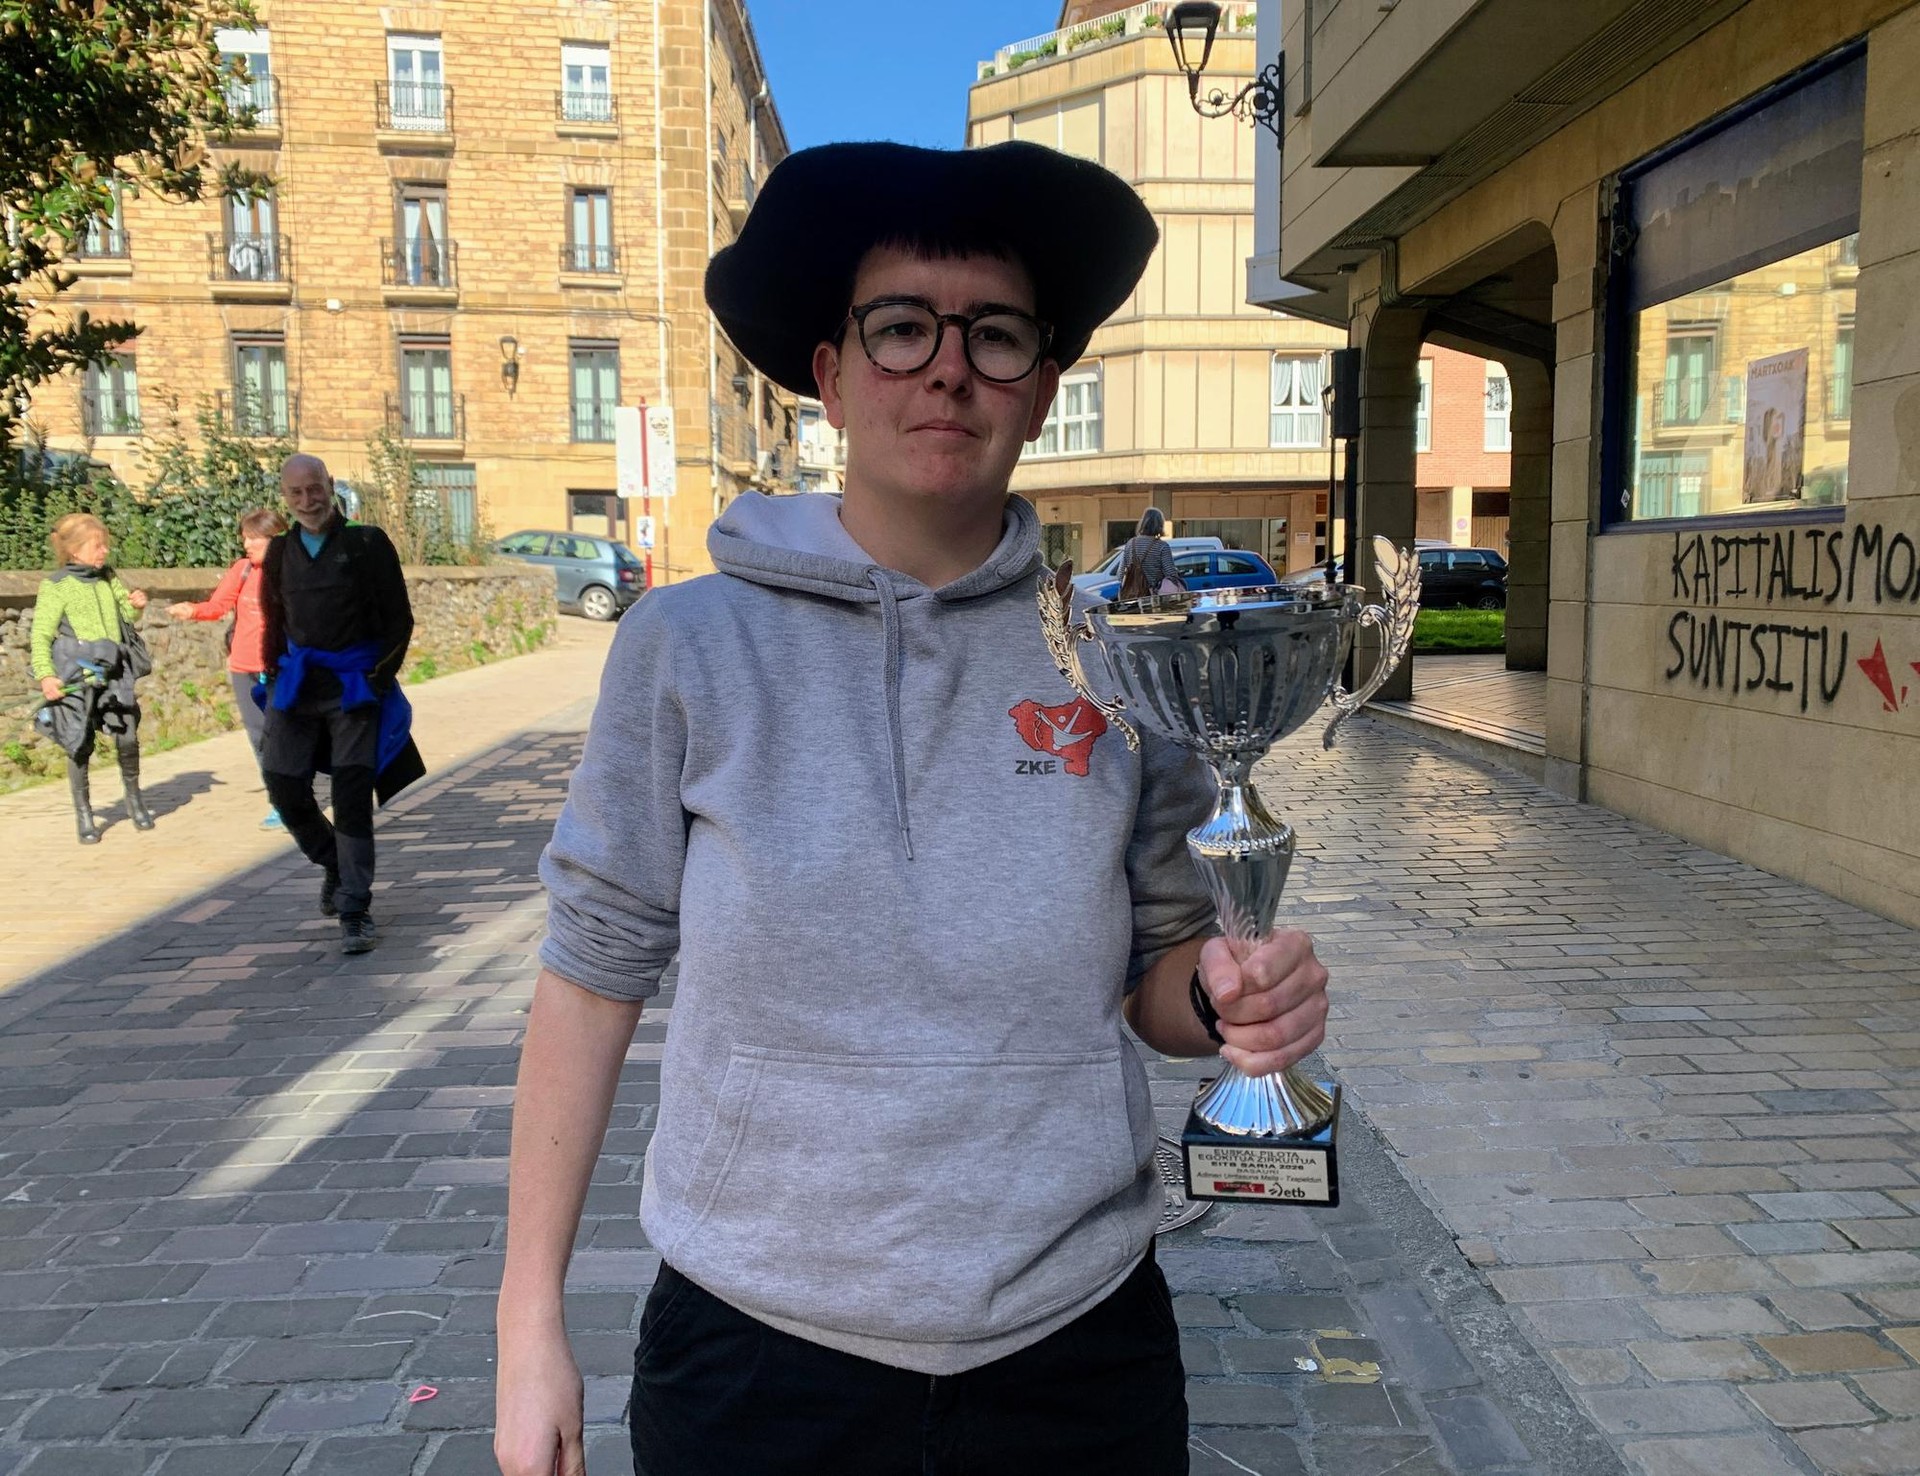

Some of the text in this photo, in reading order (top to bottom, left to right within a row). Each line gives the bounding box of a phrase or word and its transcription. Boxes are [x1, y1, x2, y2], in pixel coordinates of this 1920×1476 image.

[1672, 524, 1920, 607] KAPITALISMO
[1666, 611, 1848, 713] SUNTSITU
[1015, 760, 1057, 775] ZKE
[1197, 1153, 1317, 1165] EGOKITUA ZIRKUITUA
[1213, 1149, 1300, 1159] EUSKAL PILOTA
[1283, 1188, 1306, 1198] etb
